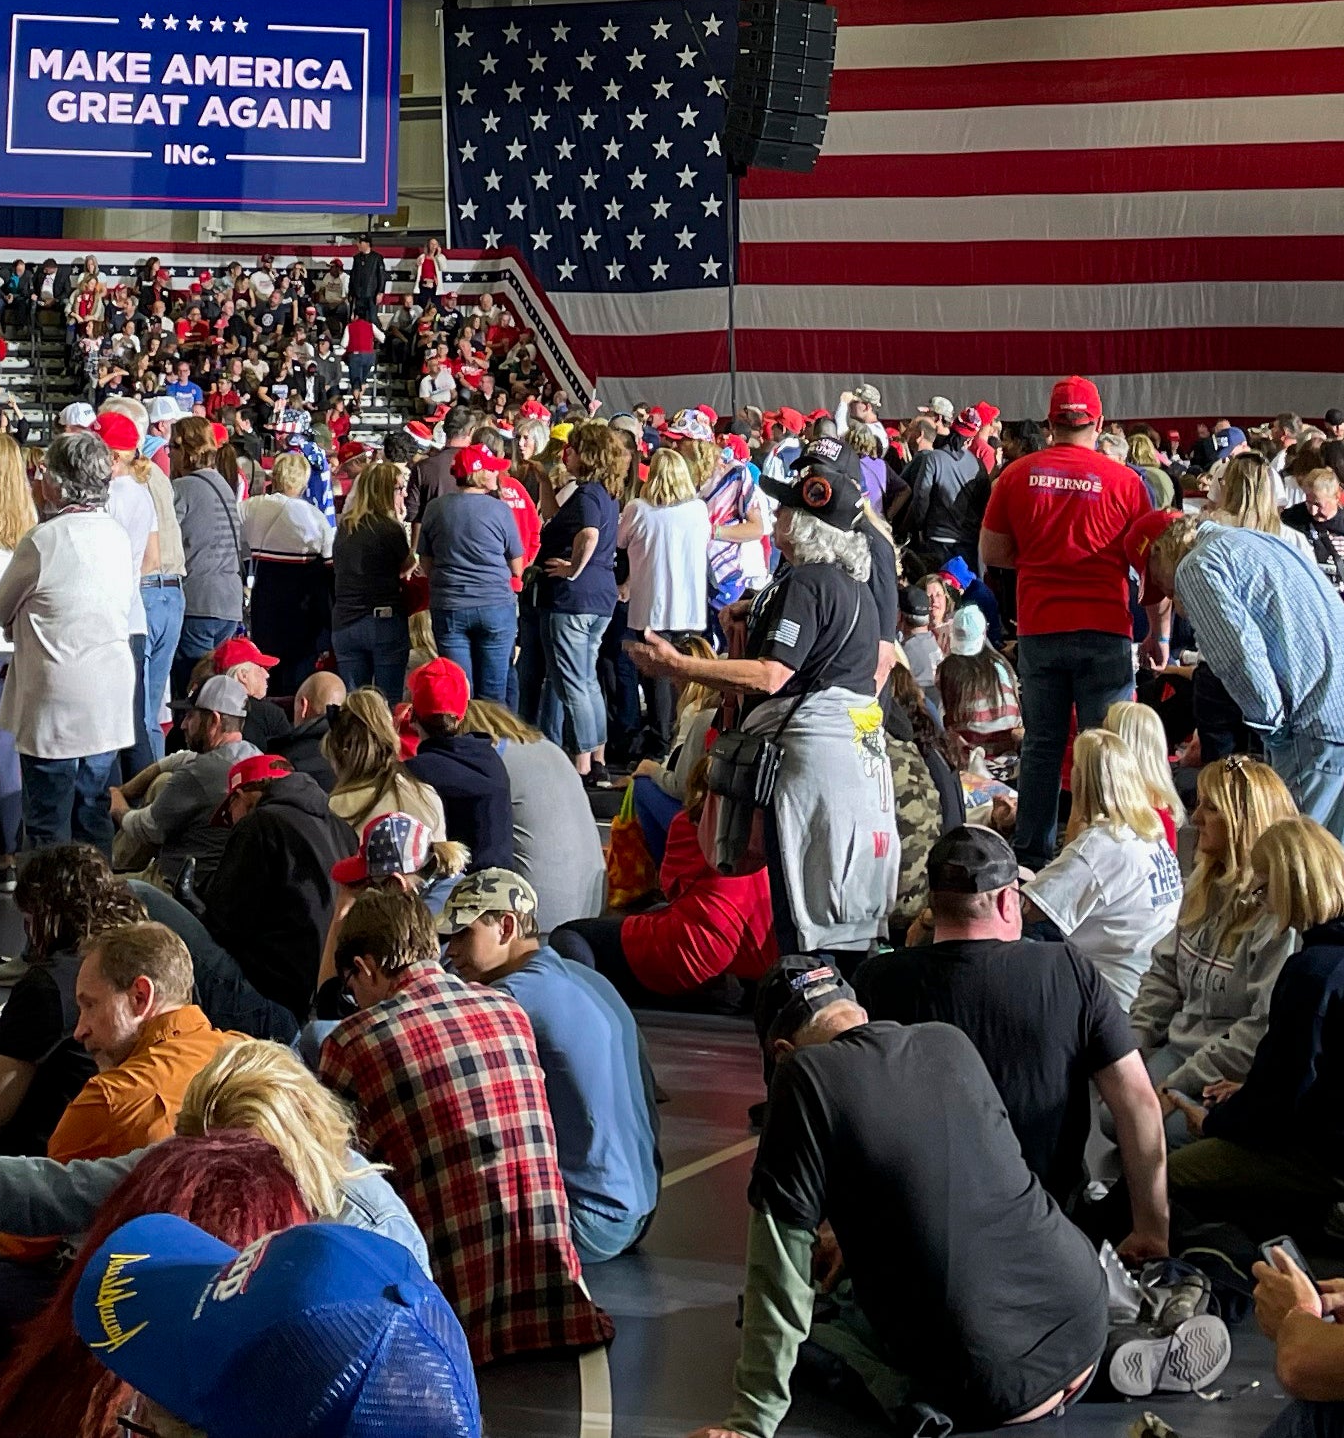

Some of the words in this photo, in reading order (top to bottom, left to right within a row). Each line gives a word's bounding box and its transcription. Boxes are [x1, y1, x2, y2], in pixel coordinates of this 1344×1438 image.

[28, 48, 152, 84] MAKE
[161, 53, 353, 91] AMERICA
[47, 90, 189, 126] GREAT
[197, 96, 332, 131] AGAIN
[164, 144, 216, 166] INC.
[1028, 475, 1092, 492] DEPERNO
